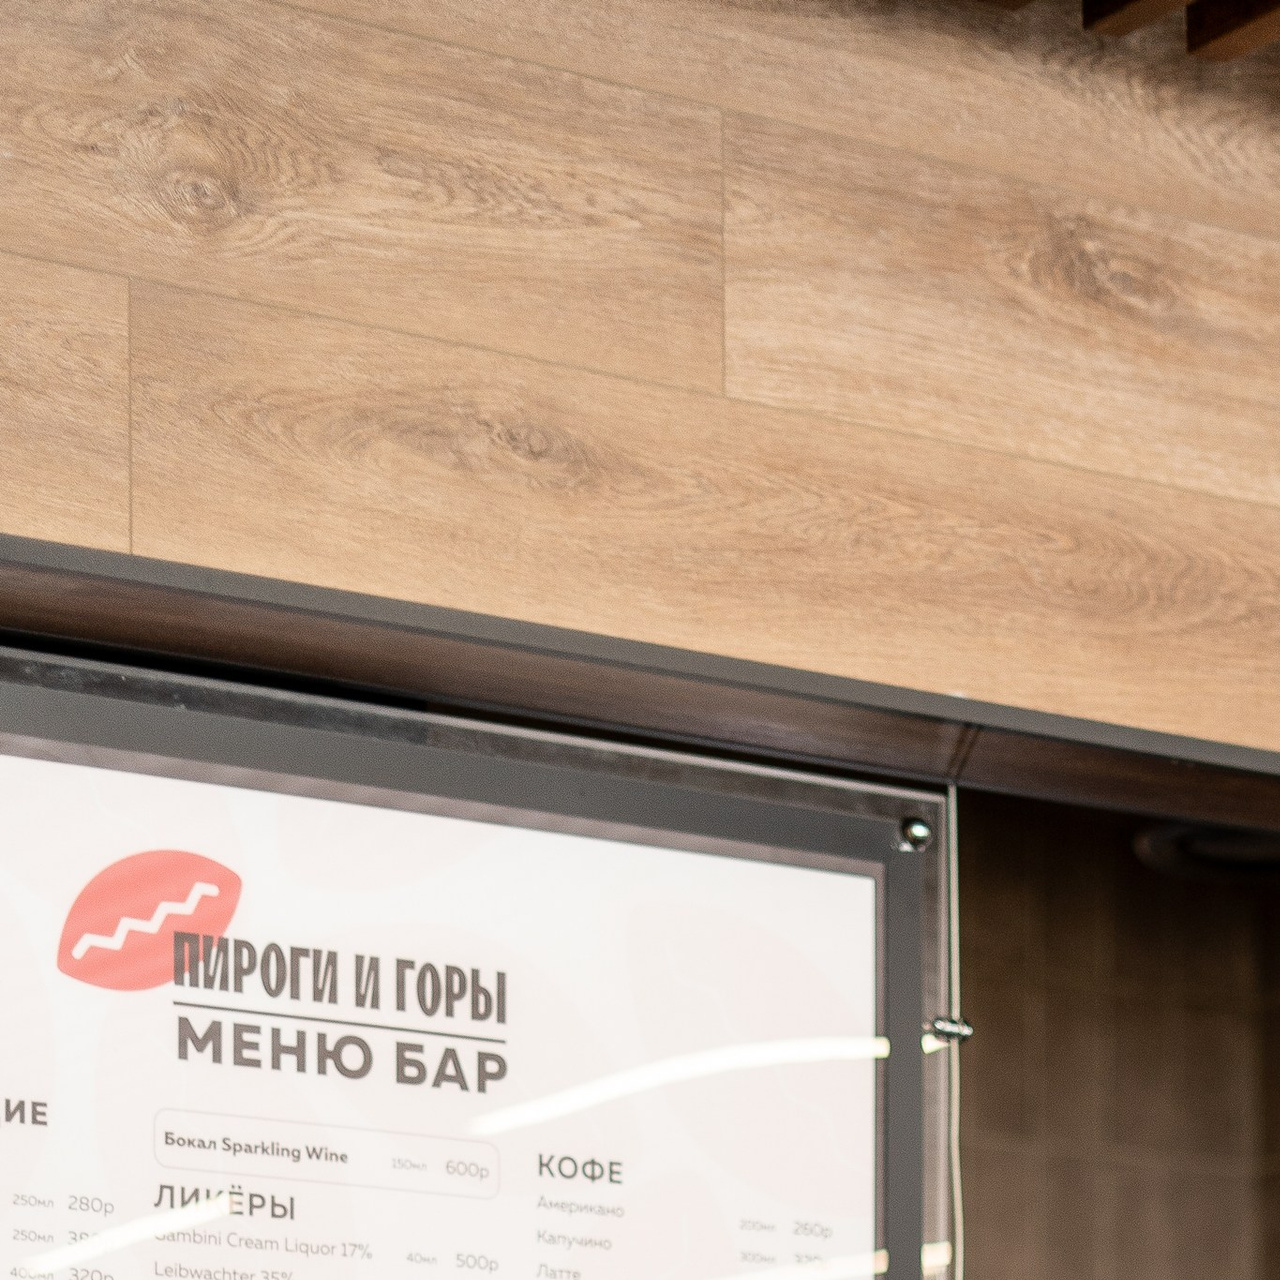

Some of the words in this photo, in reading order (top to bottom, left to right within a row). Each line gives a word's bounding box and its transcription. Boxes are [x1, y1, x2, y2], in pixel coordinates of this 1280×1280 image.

[174, 930, 339, 1005] ПИРОГИ
[354, 954, 380, 1010] И
[396, 957, 508, 1025] ГОРЫ
[177, 1016, 374, 1080] МЕНЮ
[396, 1041, 508, 1095] БАР
[164, 1131, 217, 1151] Бокал
[222, 1137, 301, 1163] Sparkling
[305, 1145, 349, 1165] Wine
[445, 1160, 490, 1180] 600р
[538, 1154, 623, 1184] КОФЕ
[68, 1194, 115, 1216] 280р
[227, 1232, 279, 1251] Cream
[285, 1238, 337, 1258] Liquor
[340, 1243, 373, 1260] 17%
[455, 1253, 500, 1274] 500р
[536, 1230, 612, 1251] Капучино
